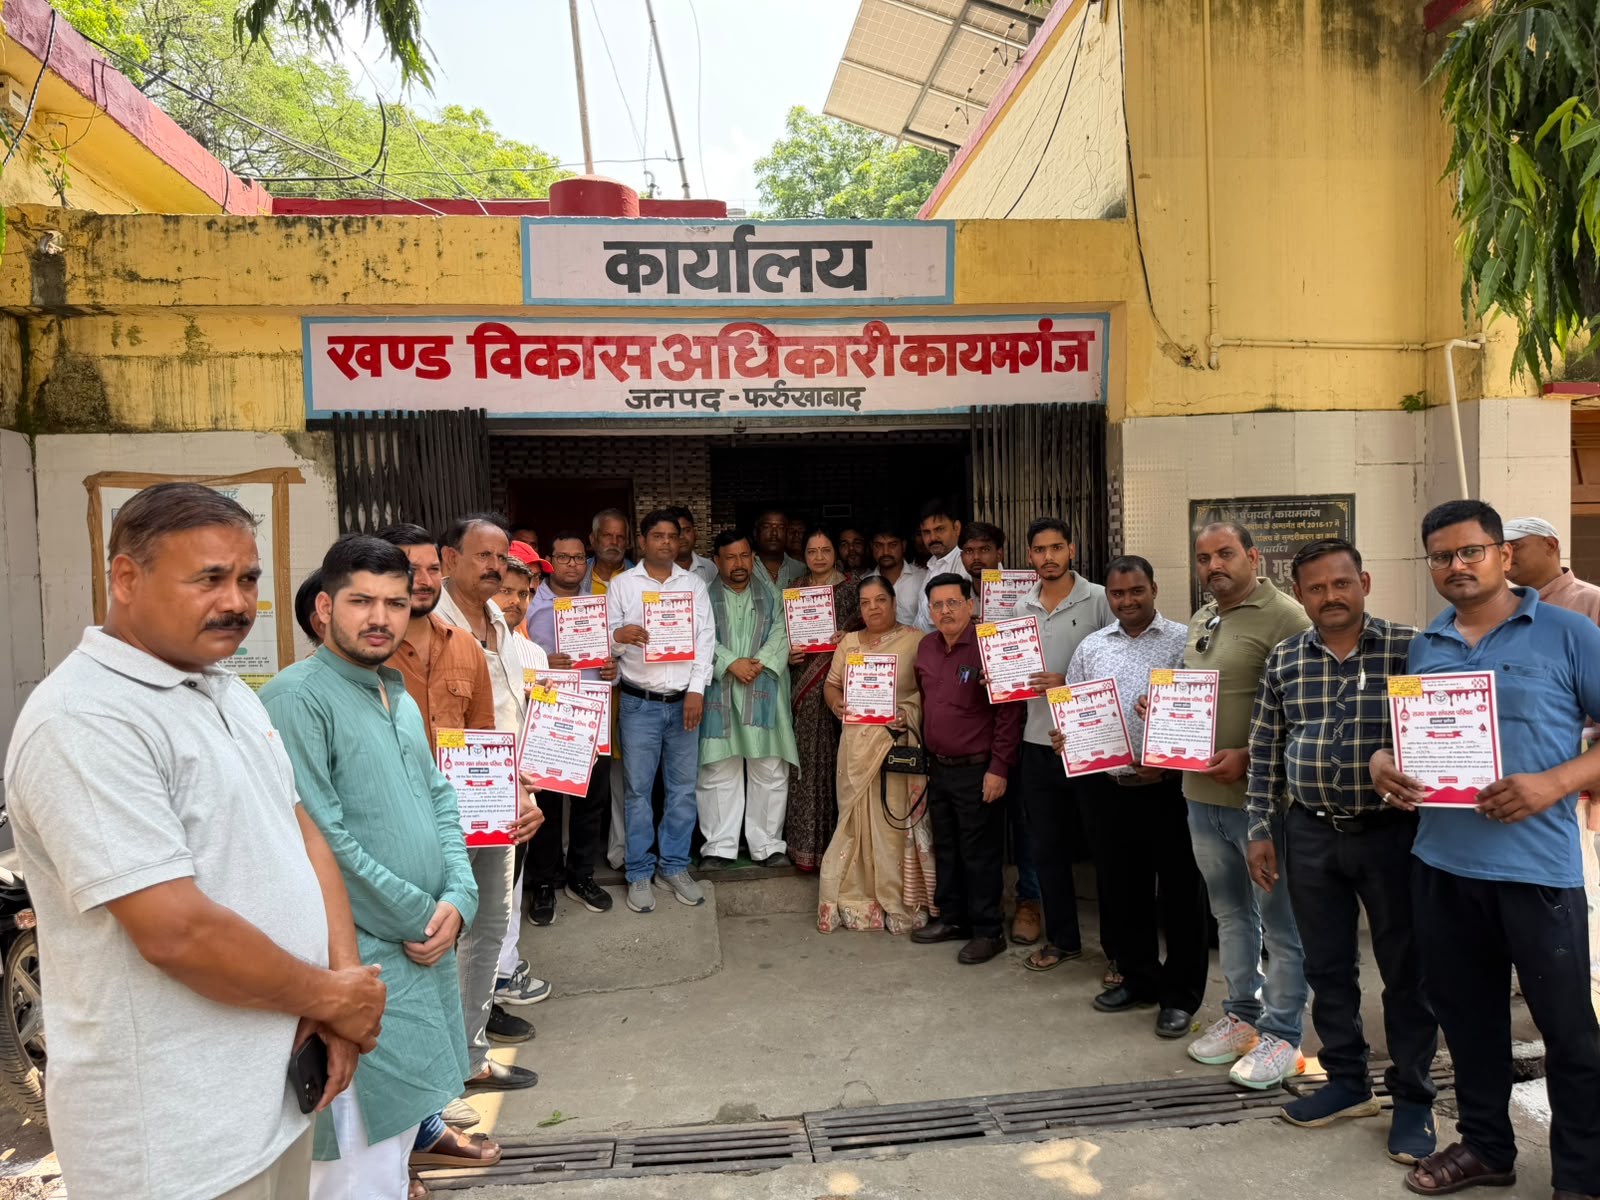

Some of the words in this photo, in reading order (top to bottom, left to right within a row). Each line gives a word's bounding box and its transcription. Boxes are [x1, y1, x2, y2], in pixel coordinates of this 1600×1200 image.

[603, 224, 873, 294] कार्यालय
[326, 335, 454, 381] खण्ड
[466, 322, 657, 383] विकास
[657, 320, 900, 382] अधिकारी
[899, 318, 1096, 377] कायमगंज
[625, 388, 725, 412] जनपद
